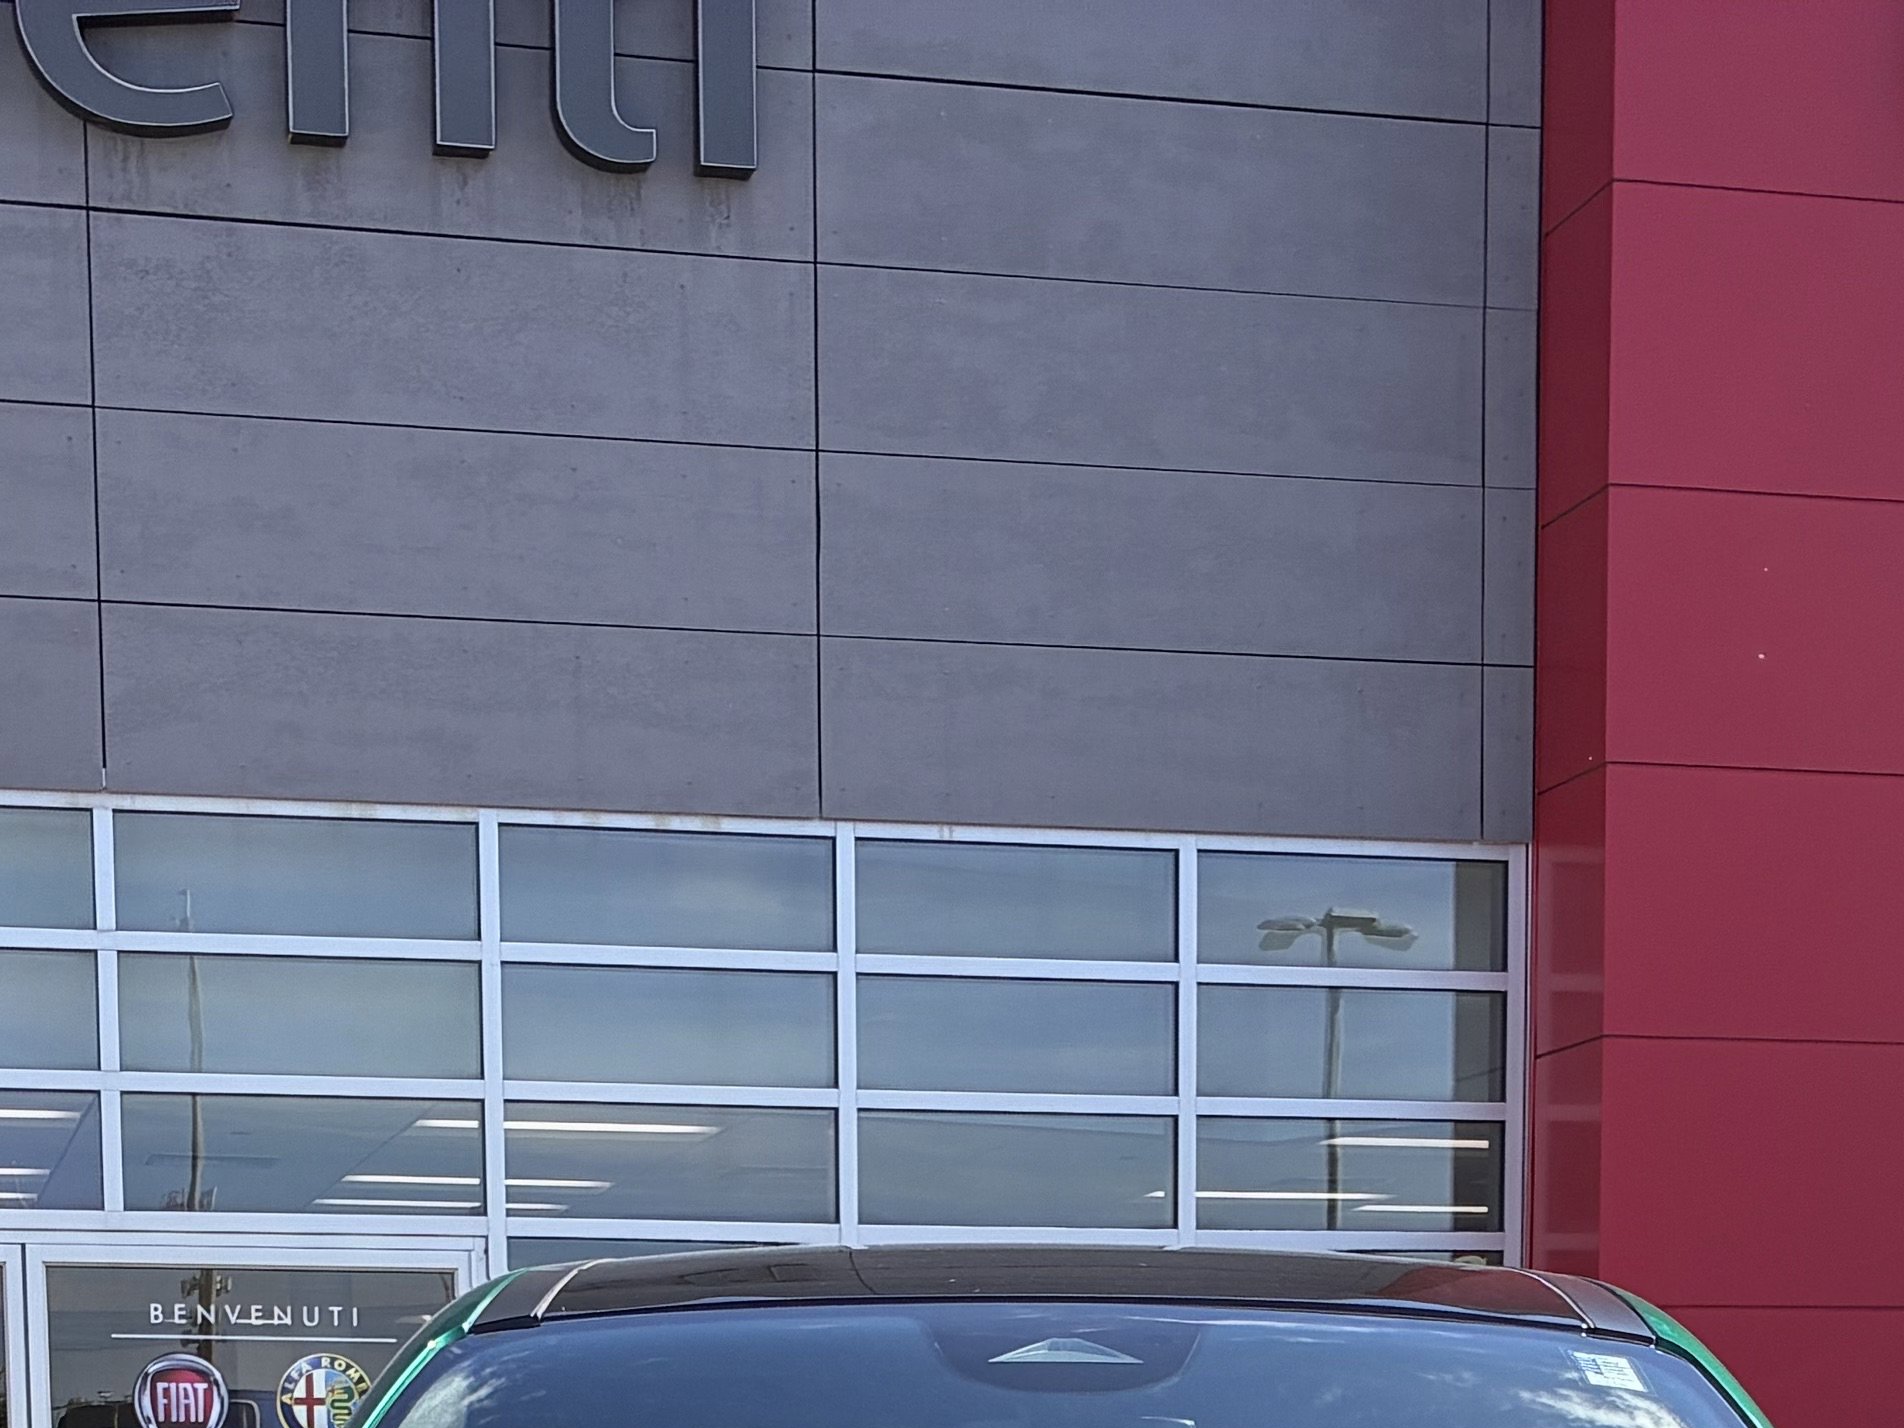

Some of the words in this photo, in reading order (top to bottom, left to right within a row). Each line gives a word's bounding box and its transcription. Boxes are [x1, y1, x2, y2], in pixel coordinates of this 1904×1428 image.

[149, 1303, 359, 1328] BENVENUTI
[281, 1361, 313, 1405] ALFA
[320, 1357, 370, 1394] ROME
[155, 1382, 209, 1424] FIAT
